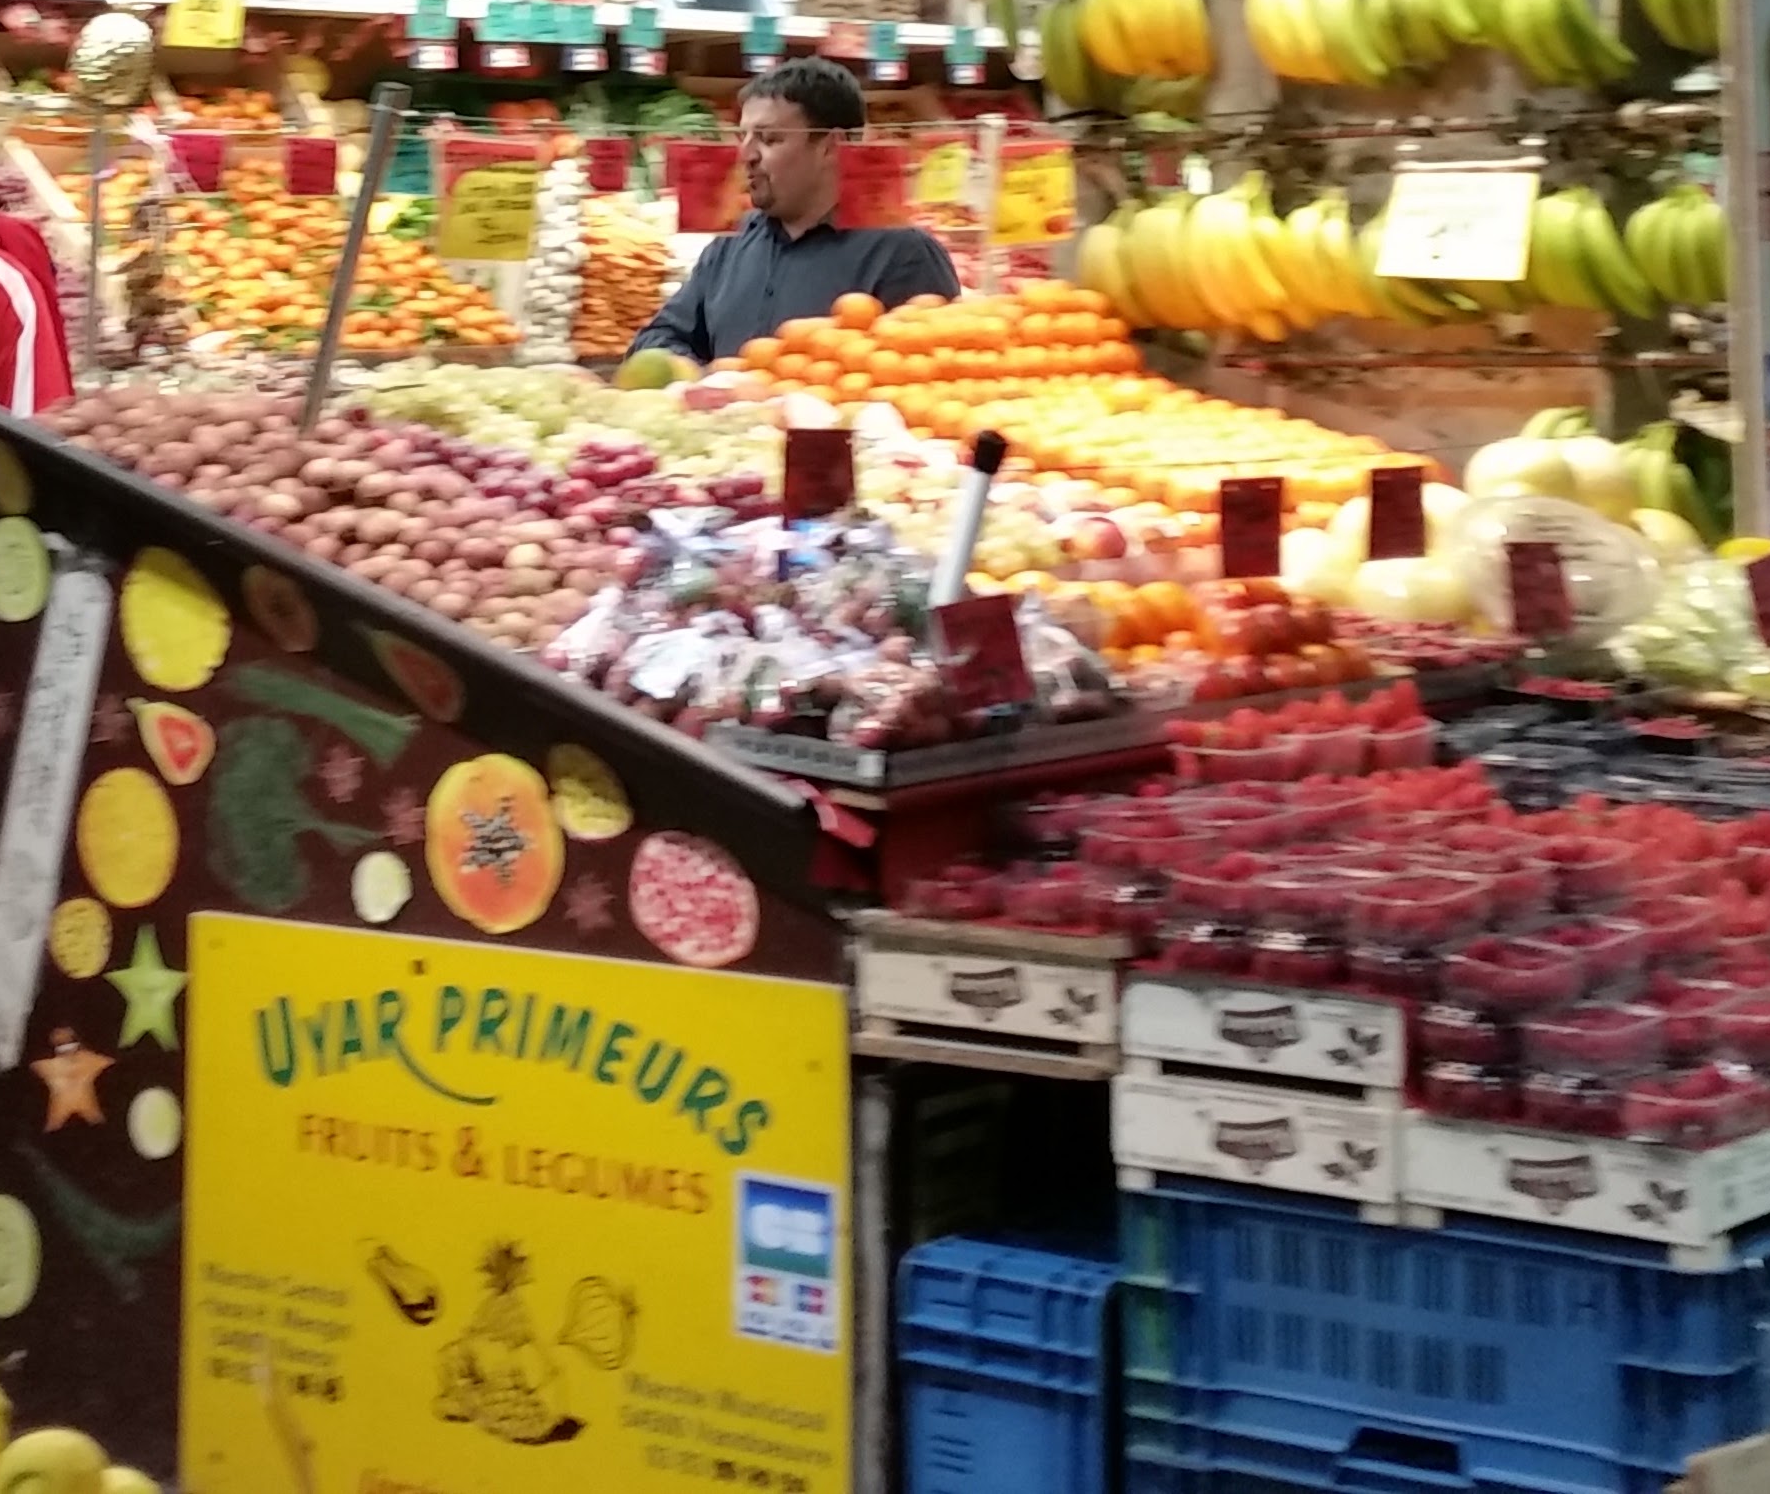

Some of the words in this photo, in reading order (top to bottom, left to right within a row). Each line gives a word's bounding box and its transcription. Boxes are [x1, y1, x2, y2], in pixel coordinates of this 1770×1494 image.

[255, 990, 495, 1106] UYAR
[434, 985, 771, 1156] PRIMEURS
[298, 1112, 438, 1172] FRUITS
[451, 1124, 489, 1180] &
[502, 1144, 713, 1215] LEGUMES
